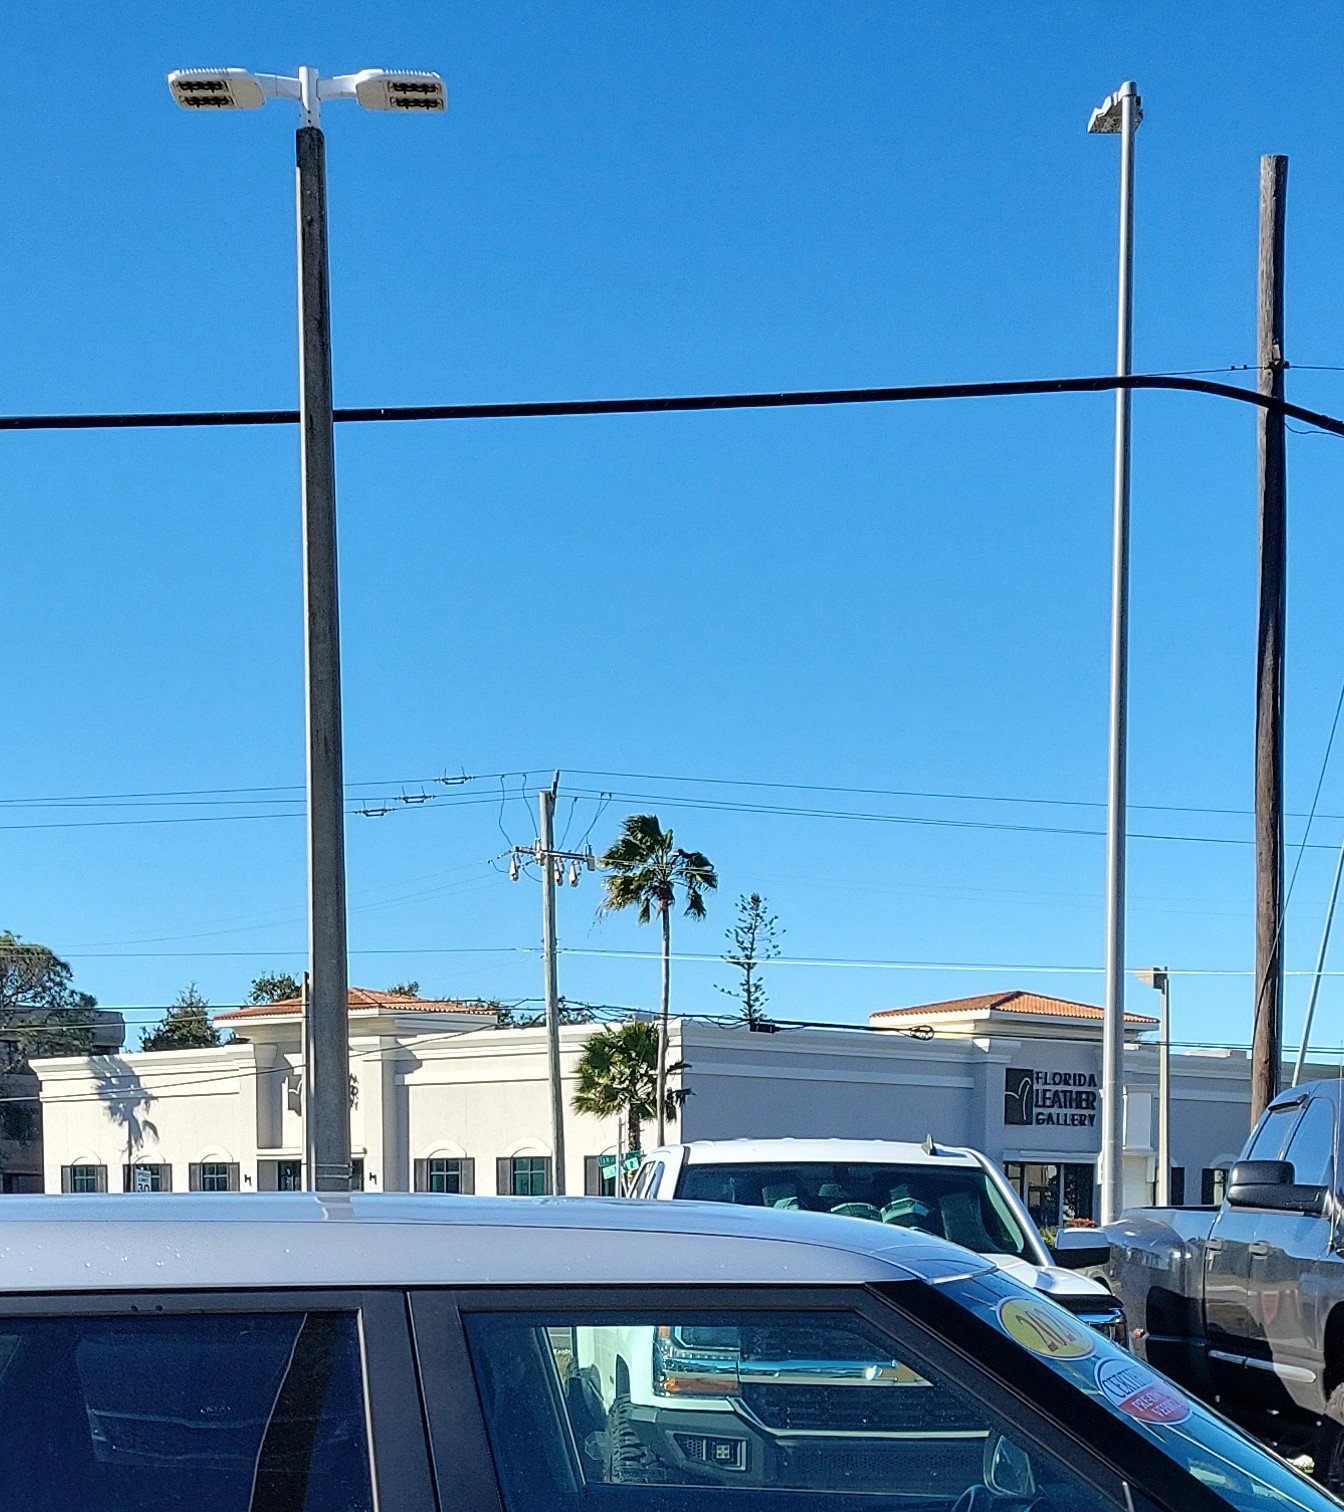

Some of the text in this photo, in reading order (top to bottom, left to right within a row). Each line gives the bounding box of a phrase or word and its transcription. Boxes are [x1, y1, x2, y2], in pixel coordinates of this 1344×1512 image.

[1035, 1071, 1097, 1087] FLORIDA
[1035, 1089, 1096, 1110] LEATHER
[1036, 1112, 1096, 1127] GALLERY
